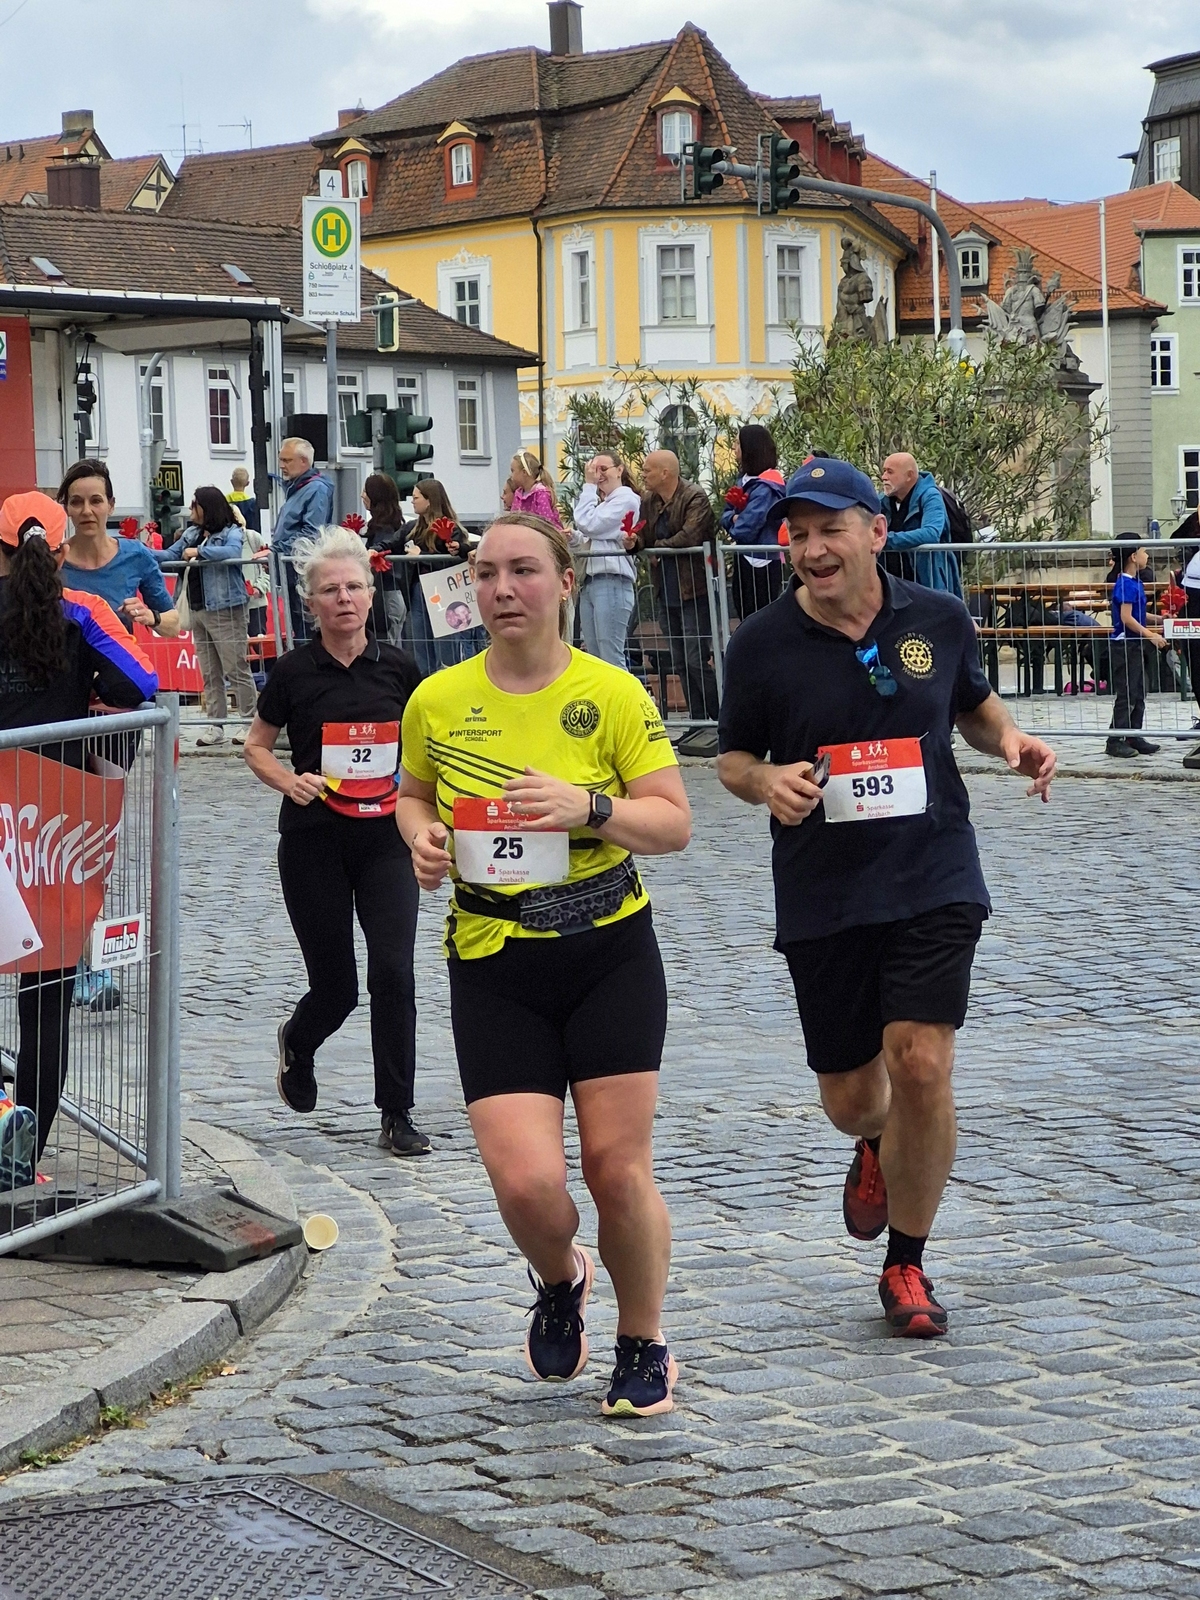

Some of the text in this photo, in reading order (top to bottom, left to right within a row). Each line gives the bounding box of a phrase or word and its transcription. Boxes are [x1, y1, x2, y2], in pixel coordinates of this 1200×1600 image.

[326, 175, 336, 192] 4
[322, 218, 342, 247] H
[309, 262, 348, 271] Schloßplatz
[455, 729, 502, 737] INTERSPORT
[351, 748, 372, 763] 32
[852, 775, 894, 798] 593
[493, 837, 523, 859] 25
[104, 924, 137, 954] müba
